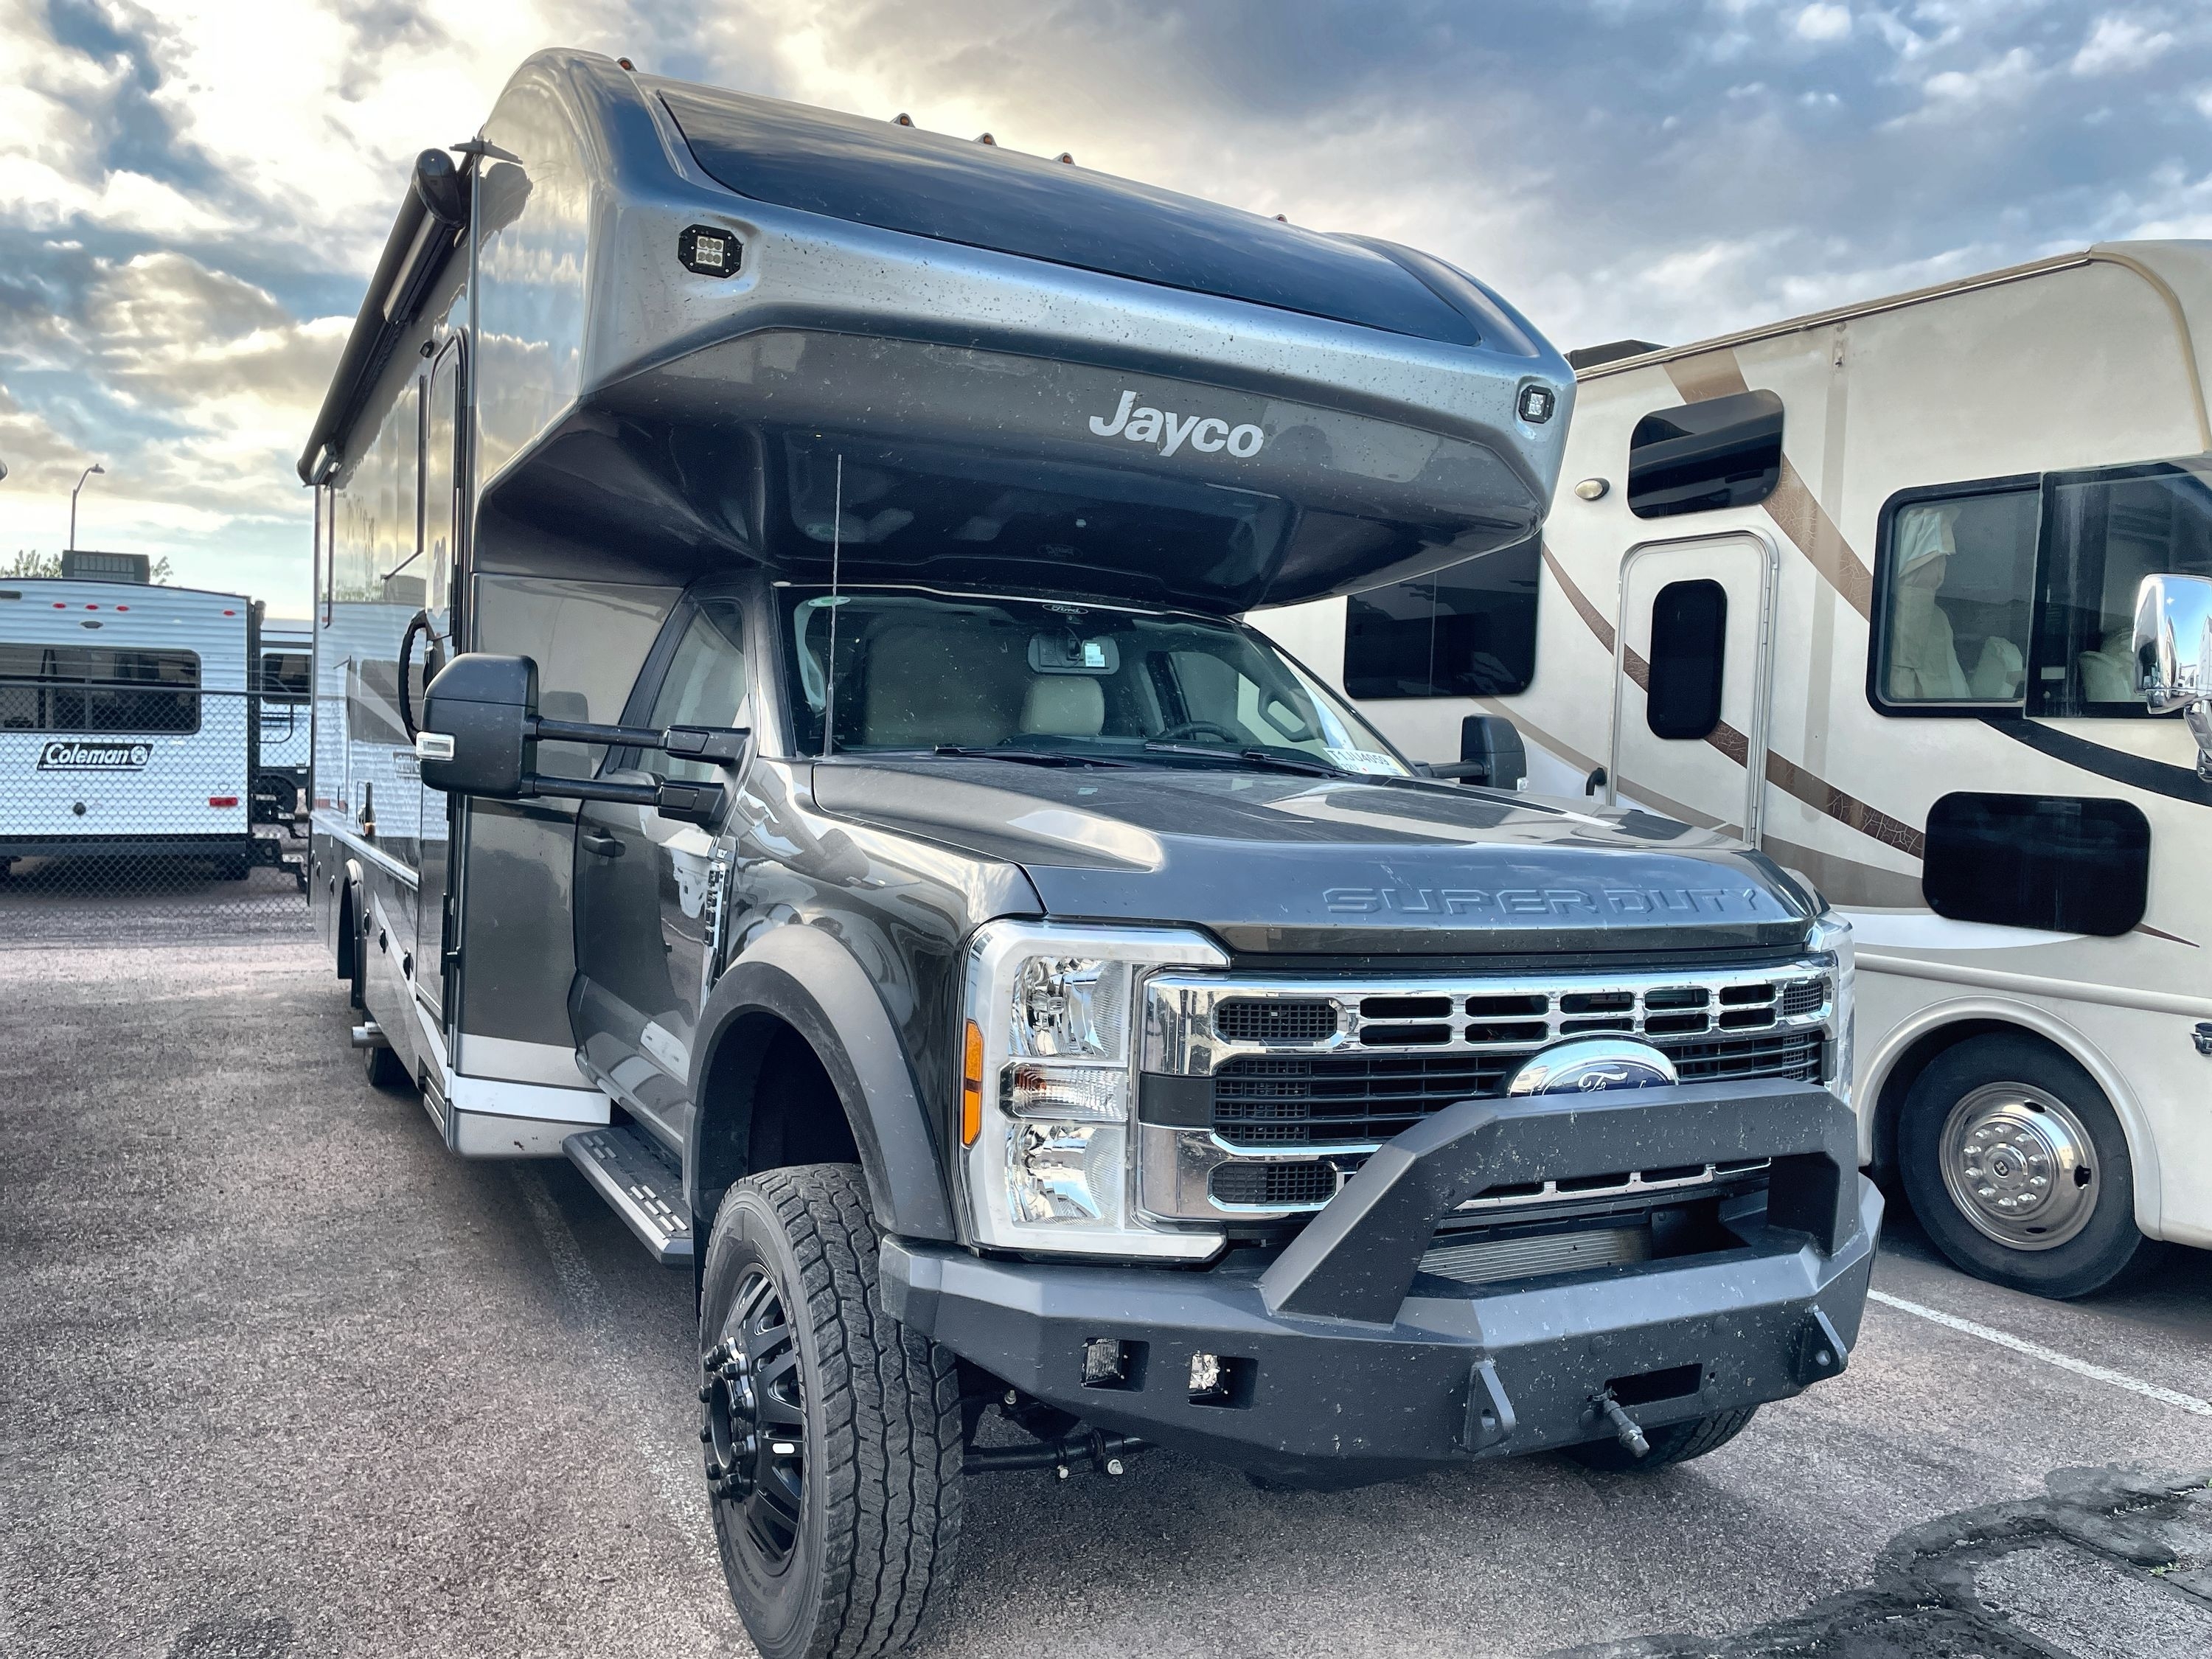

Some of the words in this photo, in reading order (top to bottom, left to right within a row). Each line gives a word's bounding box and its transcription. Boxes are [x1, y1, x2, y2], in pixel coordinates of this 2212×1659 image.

[1089, 390, 1265, 457] Jayco
[46, 743, 129, 765] Coleman
[1326, 750, 1390, 765] T1JU4059
[1322, 888, 1599, 914] SUPER
[1604, 888, 1758, 914] DUTY
